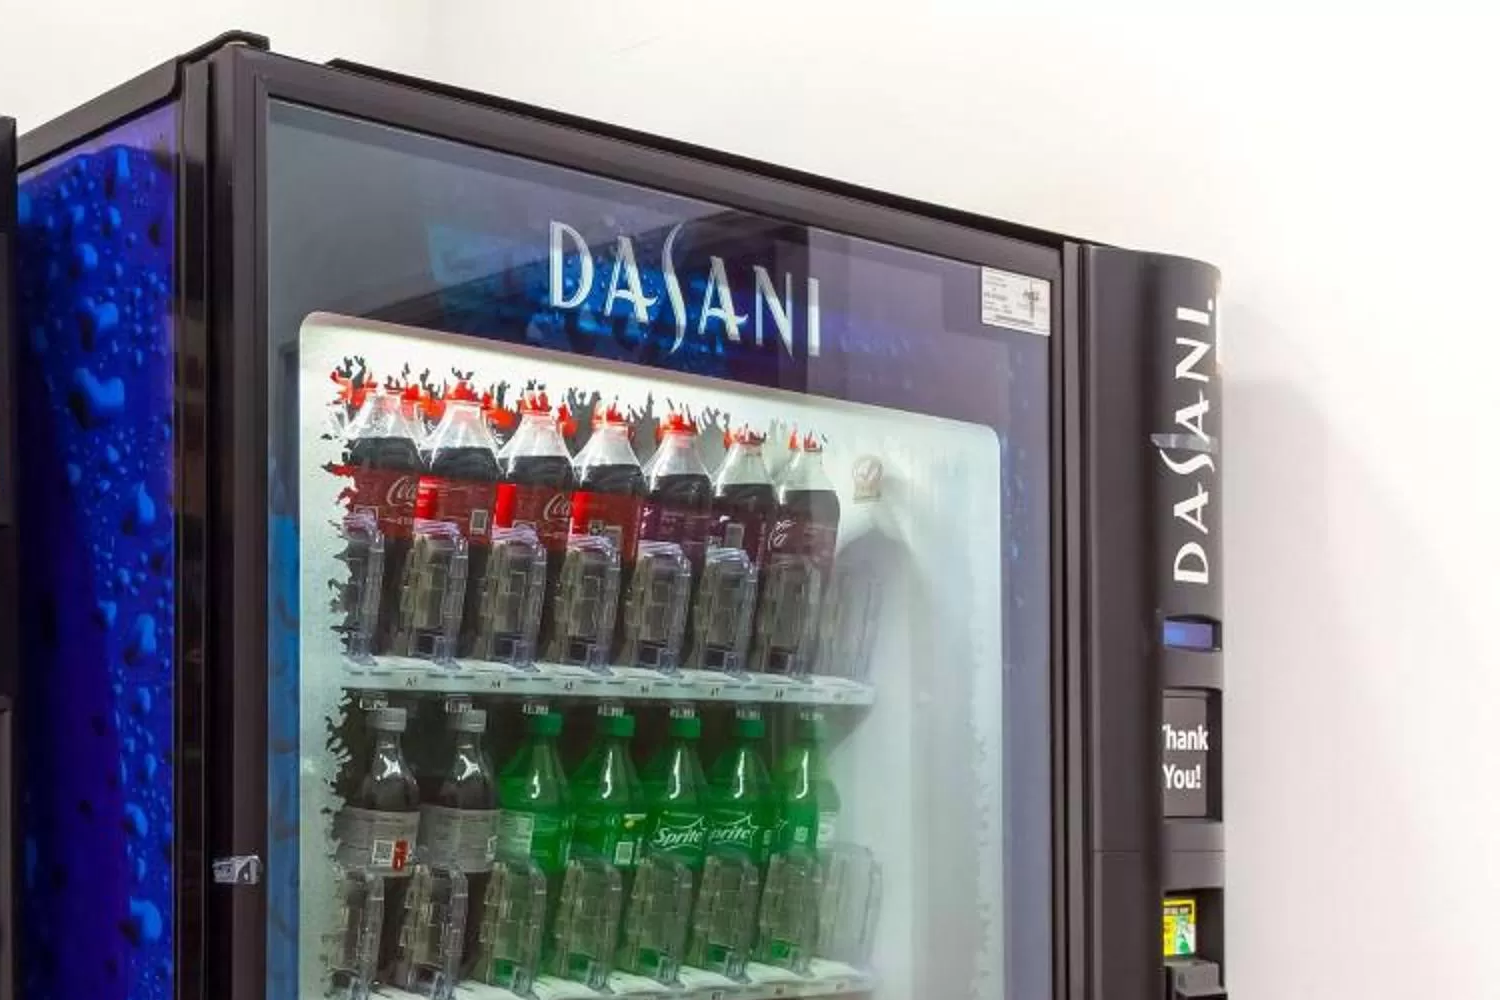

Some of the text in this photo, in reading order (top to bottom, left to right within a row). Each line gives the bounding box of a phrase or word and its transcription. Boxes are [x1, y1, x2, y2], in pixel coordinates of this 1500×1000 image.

[550, 221, 821, 358] DASANI
[1159, 306, 1215, 584] DASANI
[1162, 763, 1201, 789] You!
[653, 827, 703, 847] Sprite
